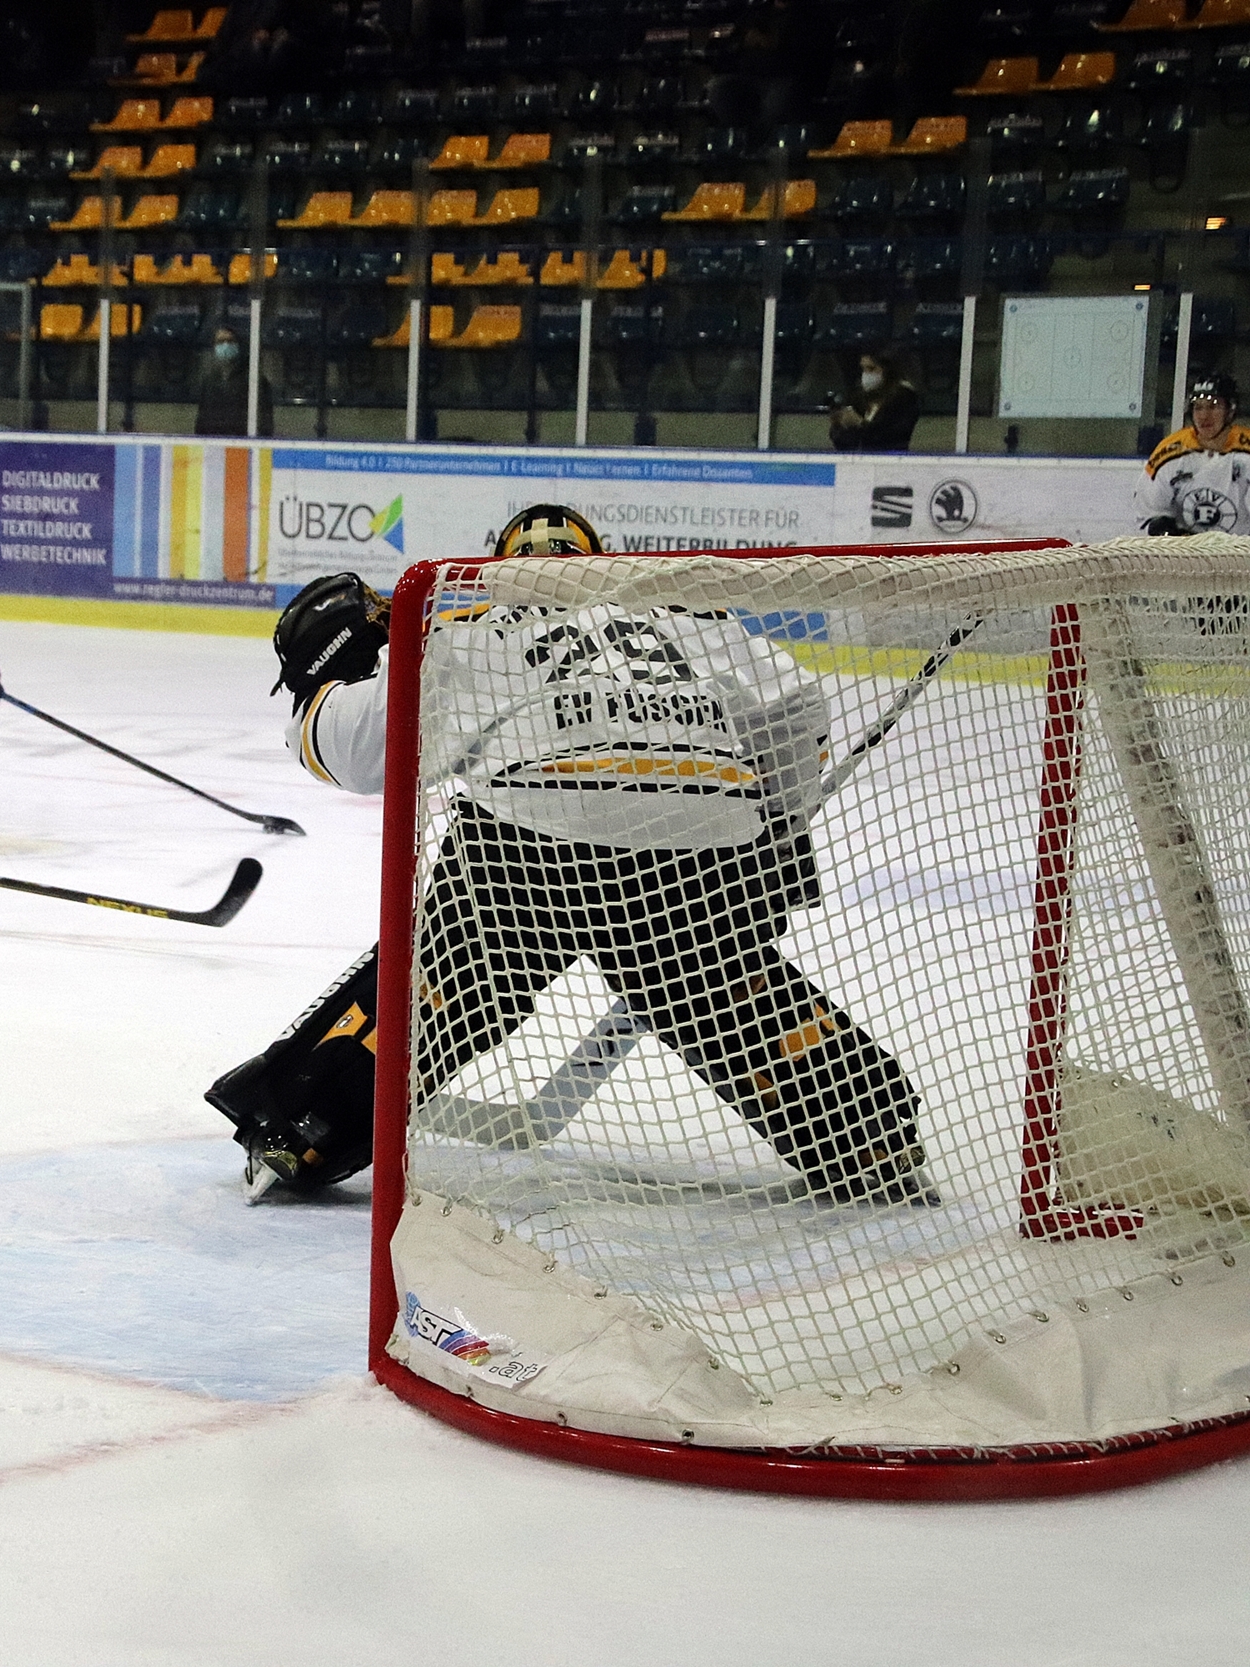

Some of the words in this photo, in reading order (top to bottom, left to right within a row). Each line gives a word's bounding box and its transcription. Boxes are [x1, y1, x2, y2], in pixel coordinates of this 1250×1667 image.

[1, 470, 99, 490] DIGITALDRUCK
[1, 495, 79, 515] SIEBDRUCK
[764, 505, 800, 529] FÜR
[1, 519, 92, 540] TEXTILDRUCK
[0, 544, 107, 565] WERBETECHNIK
[306, 625, 352, 675] VAUGHN
